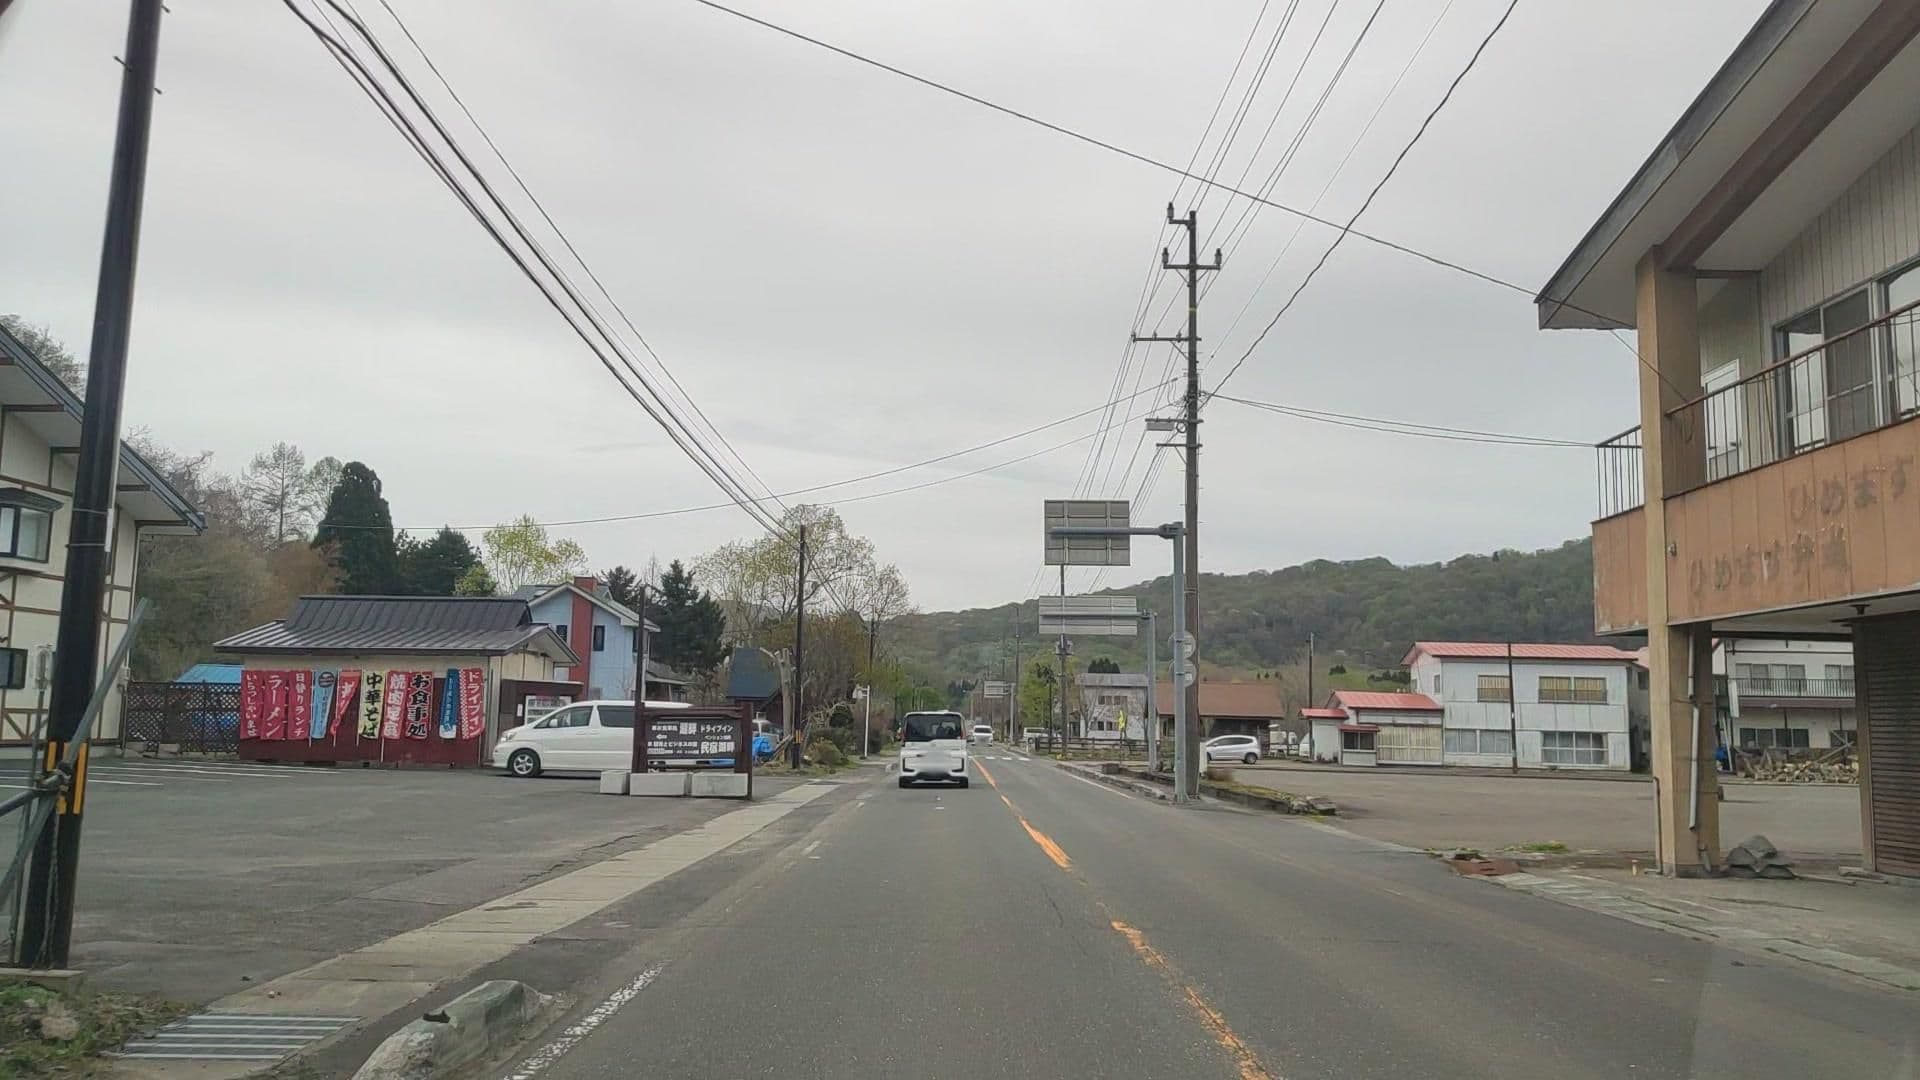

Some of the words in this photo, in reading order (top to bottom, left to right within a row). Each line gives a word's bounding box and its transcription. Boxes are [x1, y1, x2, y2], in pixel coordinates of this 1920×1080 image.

[266, 674, 282, 737] ラーメン
[293, 672, 307, 737] 日替りランチ
[362, 672, 383, 737] 中華そば
[407, 672, 430, 738] お食事処
[467, 671, 481, 736] ドライブイン
